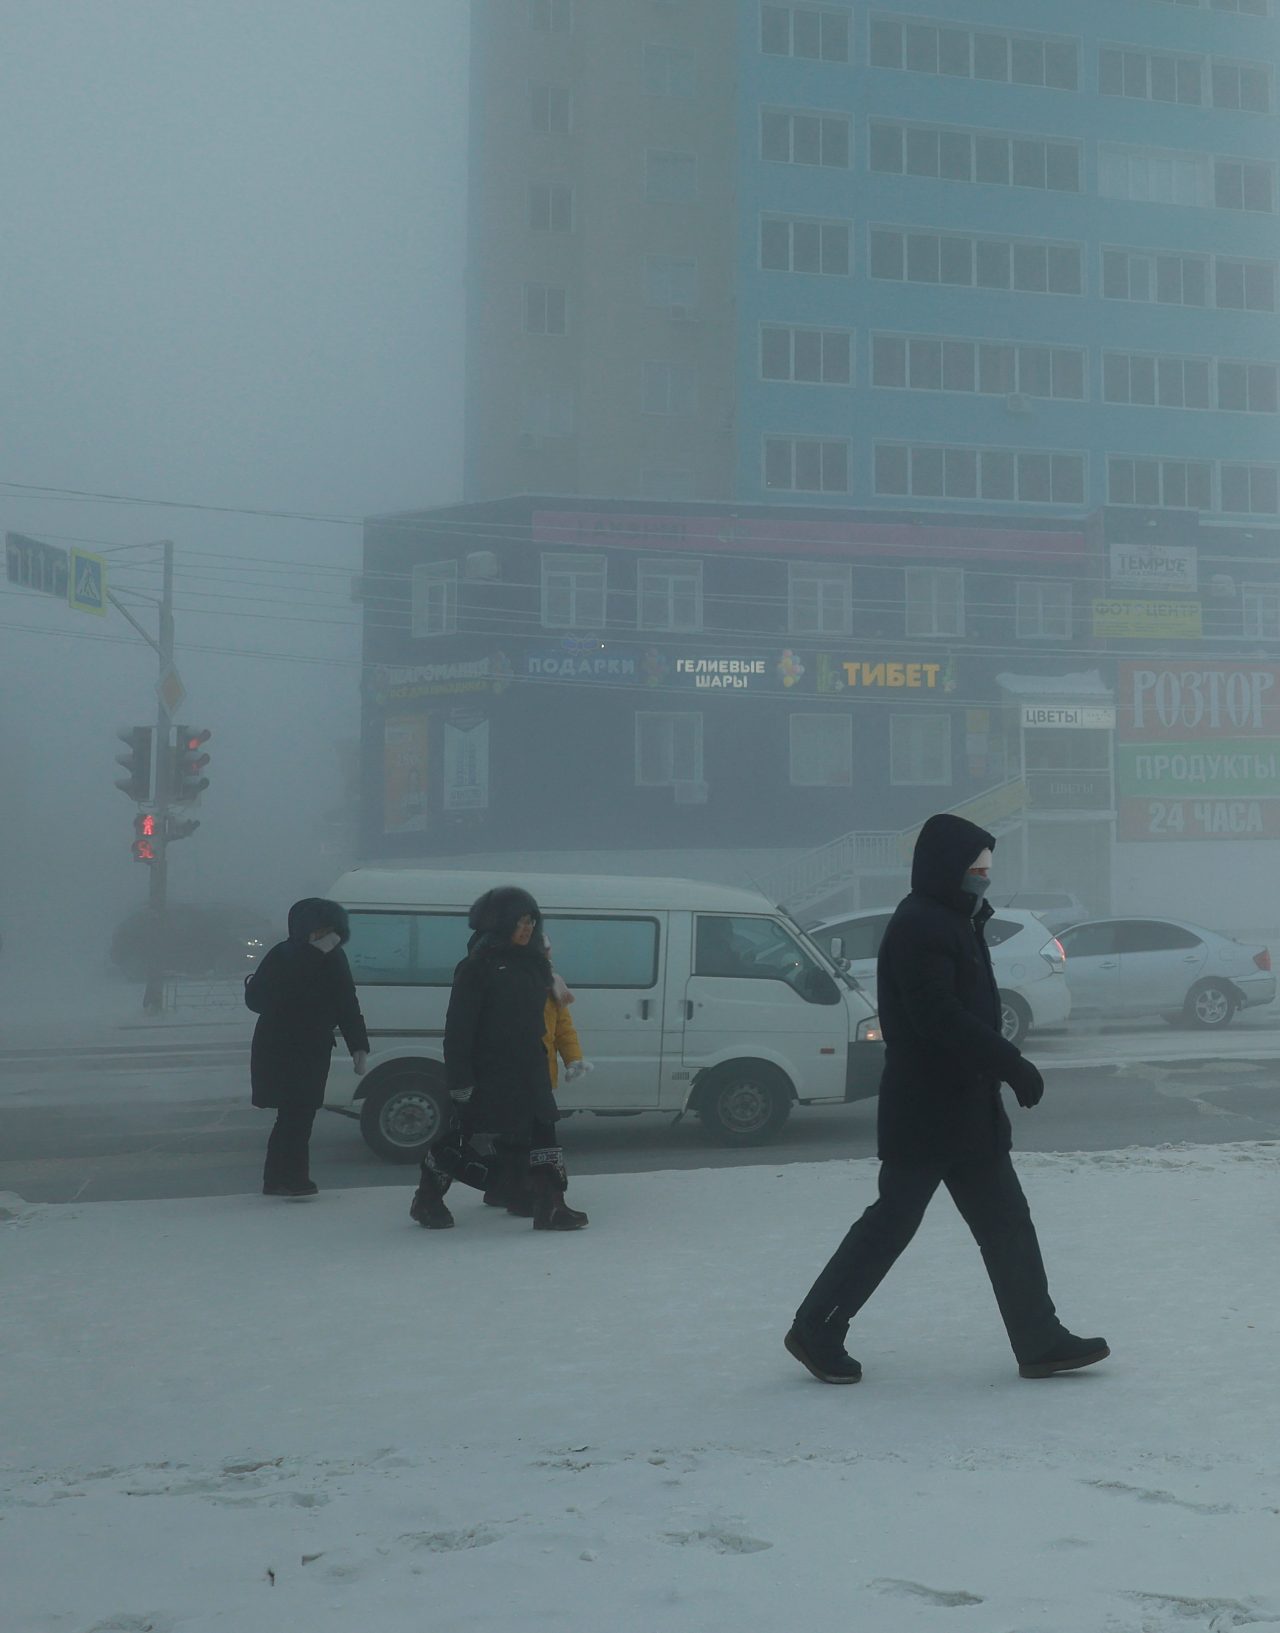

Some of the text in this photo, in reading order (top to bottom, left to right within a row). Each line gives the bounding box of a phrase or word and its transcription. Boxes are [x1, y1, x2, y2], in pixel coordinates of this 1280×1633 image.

[528, 657, 635, 676] ПОДАРКИ
[676, 659, 766, 674] ГЕЛИЕВЫЕ
[843, 662, 940, 688] ТИБЕТ
[695, 675, 748, 688] ШАРЫ
[1133, 670, 1275, 729] РОЗТОР
[1026, 710, 1078, 725] ЦВЕТЫ
[1136, 755, 1277, 783] ПРОДУКТЫ
[1149, 802, 1264, 833] 24 ЧАСА
